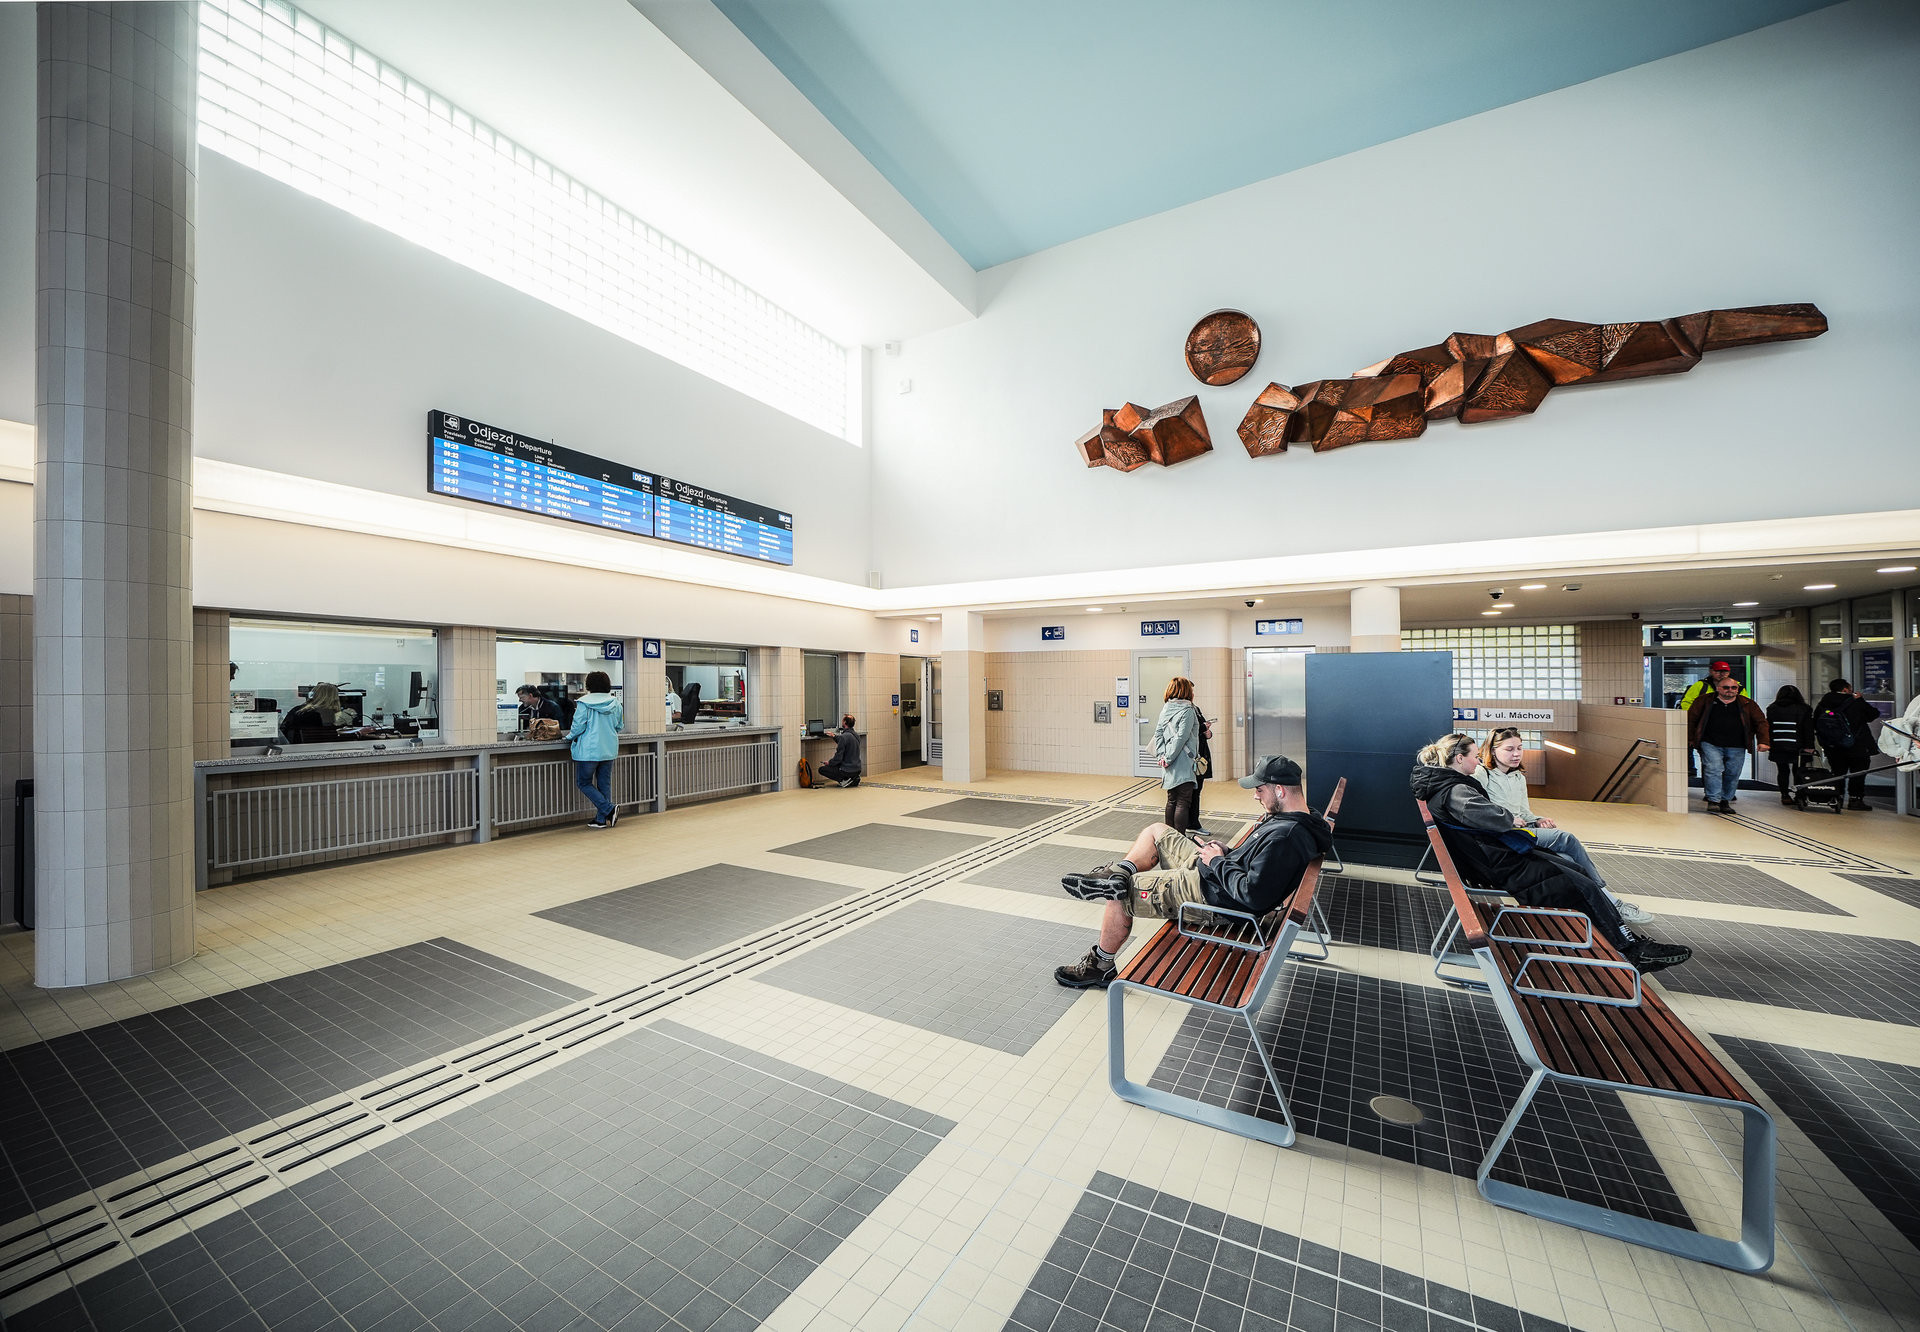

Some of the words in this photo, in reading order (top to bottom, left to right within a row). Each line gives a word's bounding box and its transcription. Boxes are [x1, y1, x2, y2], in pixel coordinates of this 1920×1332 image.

[468, 423, 513, 445] Odjezd
[520, 441, 552, 456] Departure
[675, 482, 703, 498] Odjezd
[1509, 711, 1551, 720] Máchova
